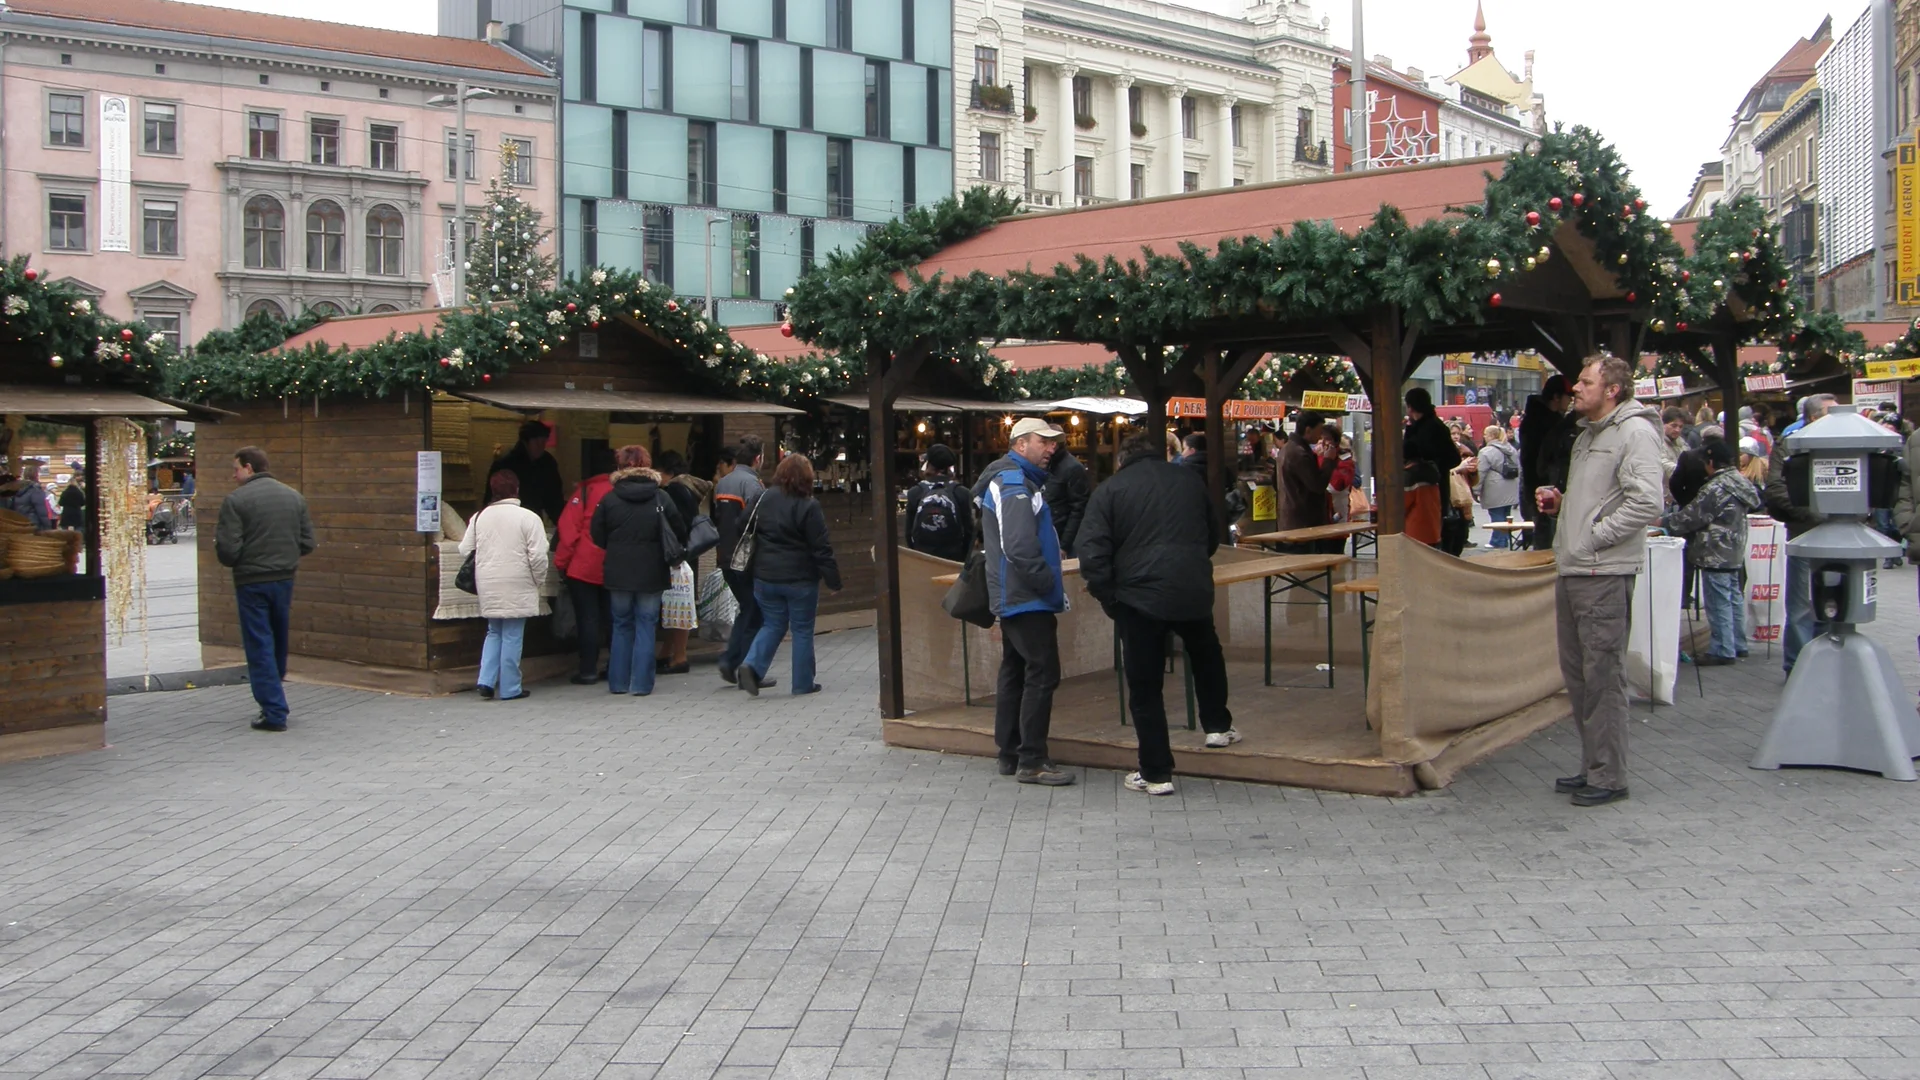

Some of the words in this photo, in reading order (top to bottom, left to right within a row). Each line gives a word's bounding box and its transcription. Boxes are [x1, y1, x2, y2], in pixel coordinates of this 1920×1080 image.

[1902, 173, 1913, 216] AGENCY
[1902, 225, 1913, 272] STUDENT
[1814, 476, 1836, 485] JOHNNY
[1837, 476, 1857, 485] SERVIS
[1751, 545, 1777, 558] AVE
[1752, 586, 1779, 598] AVE
[1755, 626, 1780, 638] AVE
